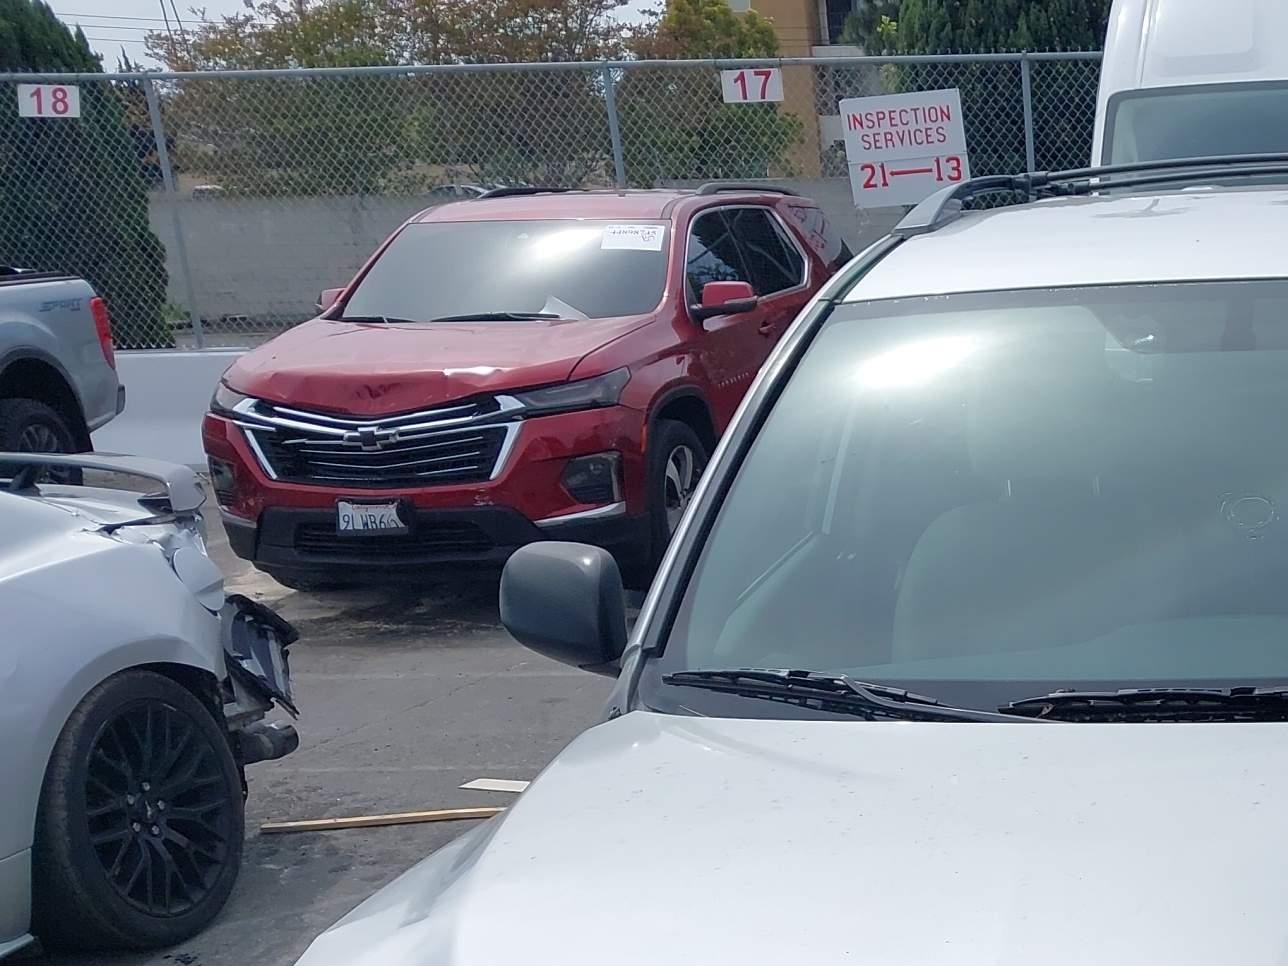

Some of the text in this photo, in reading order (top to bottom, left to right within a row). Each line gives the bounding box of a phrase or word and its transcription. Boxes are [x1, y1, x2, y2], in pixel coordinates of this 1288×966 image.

[733, 70, 772, 100] 17
[30, 87, 69, 115] 18
[847, 104, 952, 132] INSPECTION
[860, 126, 947, 151] SERVICES
[860, 155, 962, 189] 21 13
